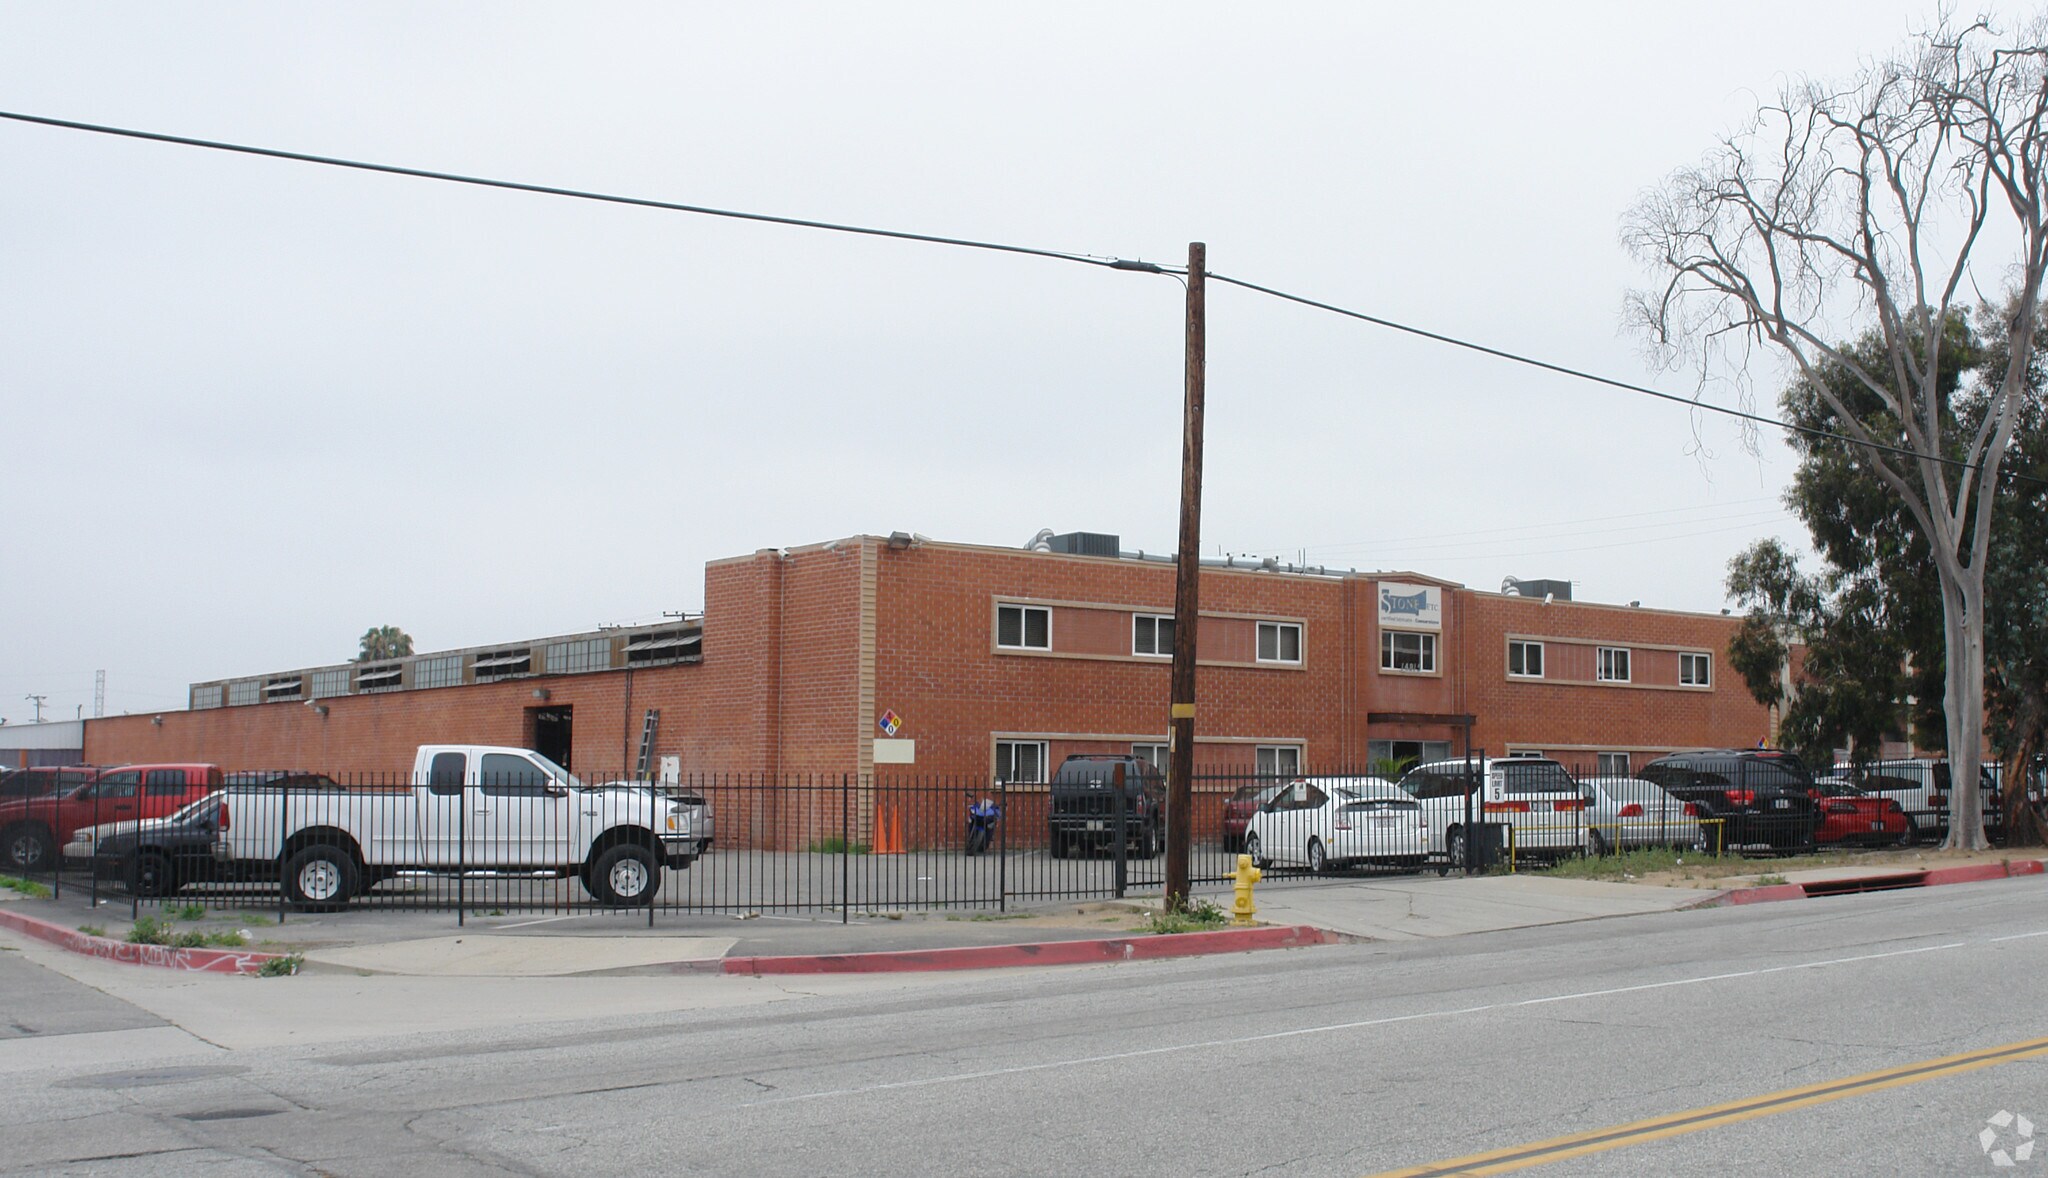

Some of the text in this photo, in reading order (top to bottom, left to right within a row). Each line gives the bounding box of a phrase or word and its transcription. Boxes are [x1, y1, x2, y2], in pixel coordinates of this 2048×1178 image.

[1381, 592, 1420, 614] STONE
[893, 718, 899, 727] 0
[888, 725, 894, 734] 0
[1494, 788, 1500, 800] 5
